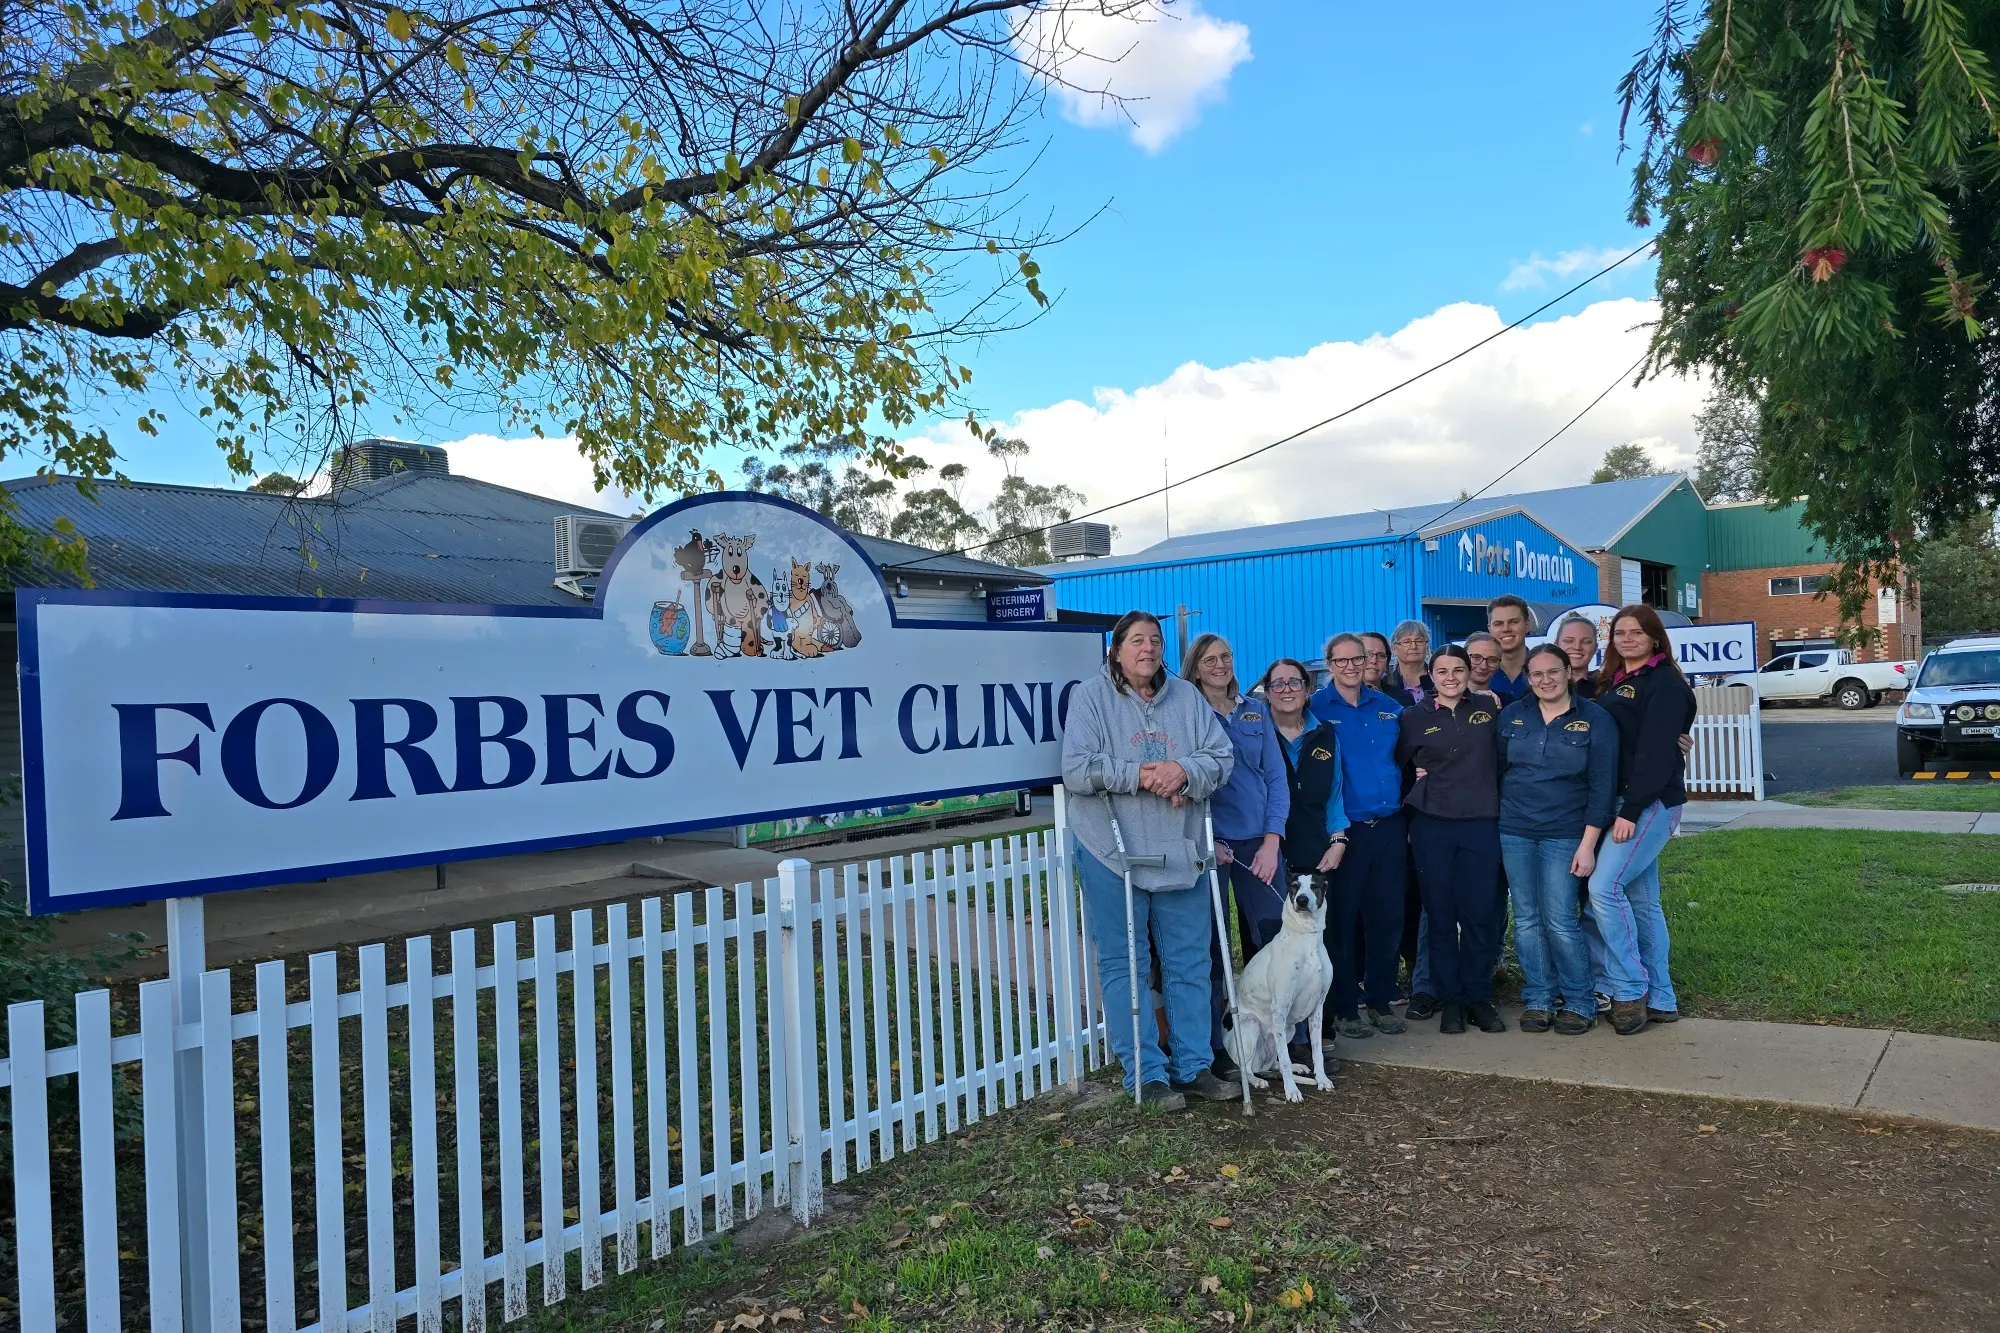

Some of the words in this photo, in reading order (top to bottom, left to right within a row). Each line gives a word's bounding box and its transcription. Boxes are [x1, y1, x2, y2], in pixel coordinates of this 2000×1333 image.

[1475, 533, 1511, 577] Pets
[1515, 540, 1573, 584] Domain
[990, 593, 1041, 606] VETERINARY
[996, 607, 1036, 618] SURGERY
[1674, 640, 1743, 664] INIC
[110, 689, 675, 821] FORBES
[703, 686, 873, 772] VET
